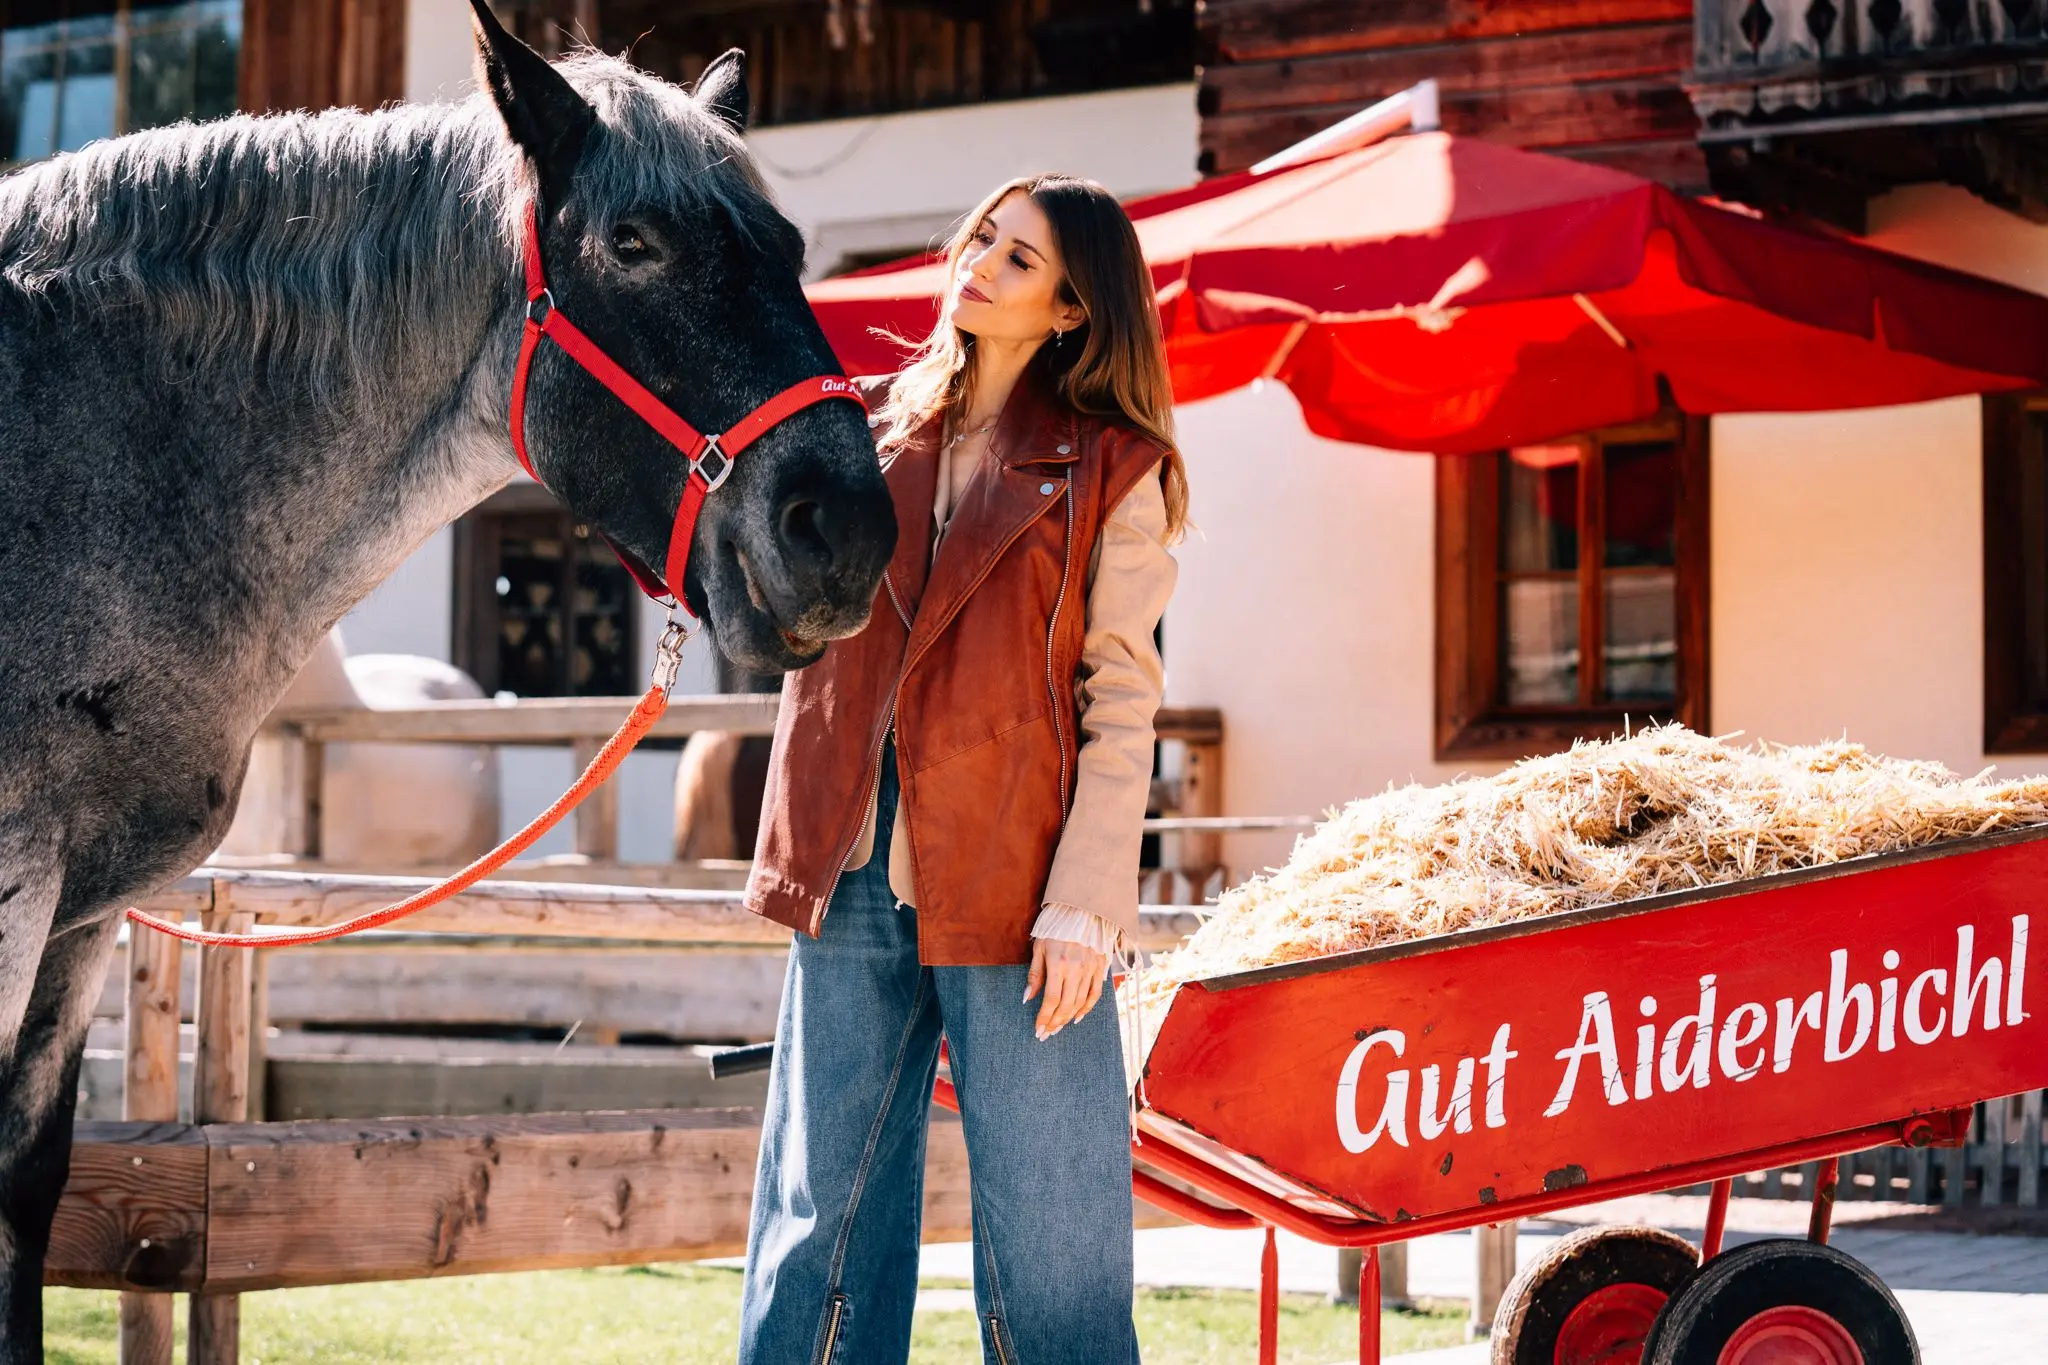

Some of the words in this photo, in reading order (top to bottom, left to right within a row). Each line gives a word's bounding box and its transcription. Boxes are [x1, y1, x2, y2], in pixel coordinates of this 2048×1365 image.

[821, 378, 847, 393] Gut
[1335, 1023, 1518, 1154] Gut
[1542, 913, 2032, 1118] Aiderbichl
